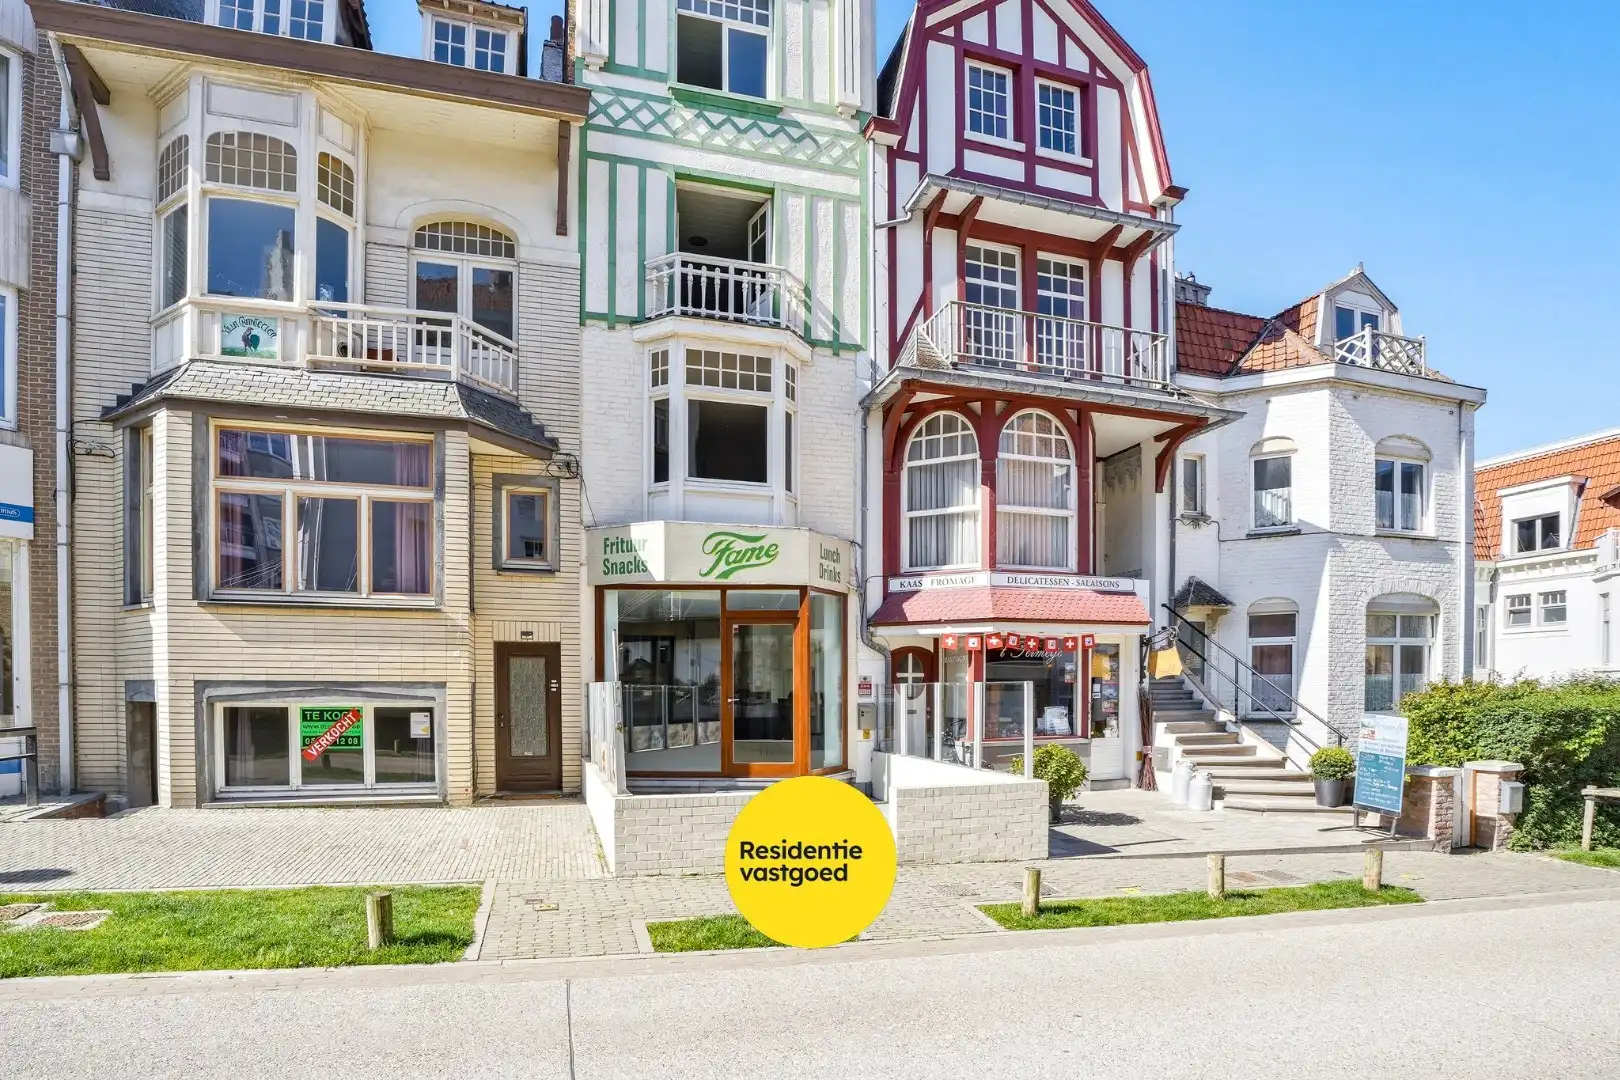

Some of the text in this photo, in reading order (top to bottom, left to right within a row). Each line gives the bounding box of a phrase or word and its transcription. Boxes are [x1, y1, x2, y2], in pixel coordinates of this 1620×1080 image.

[603, 536, 648, 555] Frituur
[699, 531, 779, 579] Fame
[819, 542, 841, 564] Lunch
[602, 556, 648, 576] Snacks
[818, 562, 841, 584] Drinks
[899, 576, 977, 589] KAAS FROMAGE
[1007, 576, 1070, 587] DELICATESSEN
[1075, 578, 1121, 589] SALAISONS
[304, 711, 347, 721] TE KO
[307, 711, 357, 757] VERKOCHT
